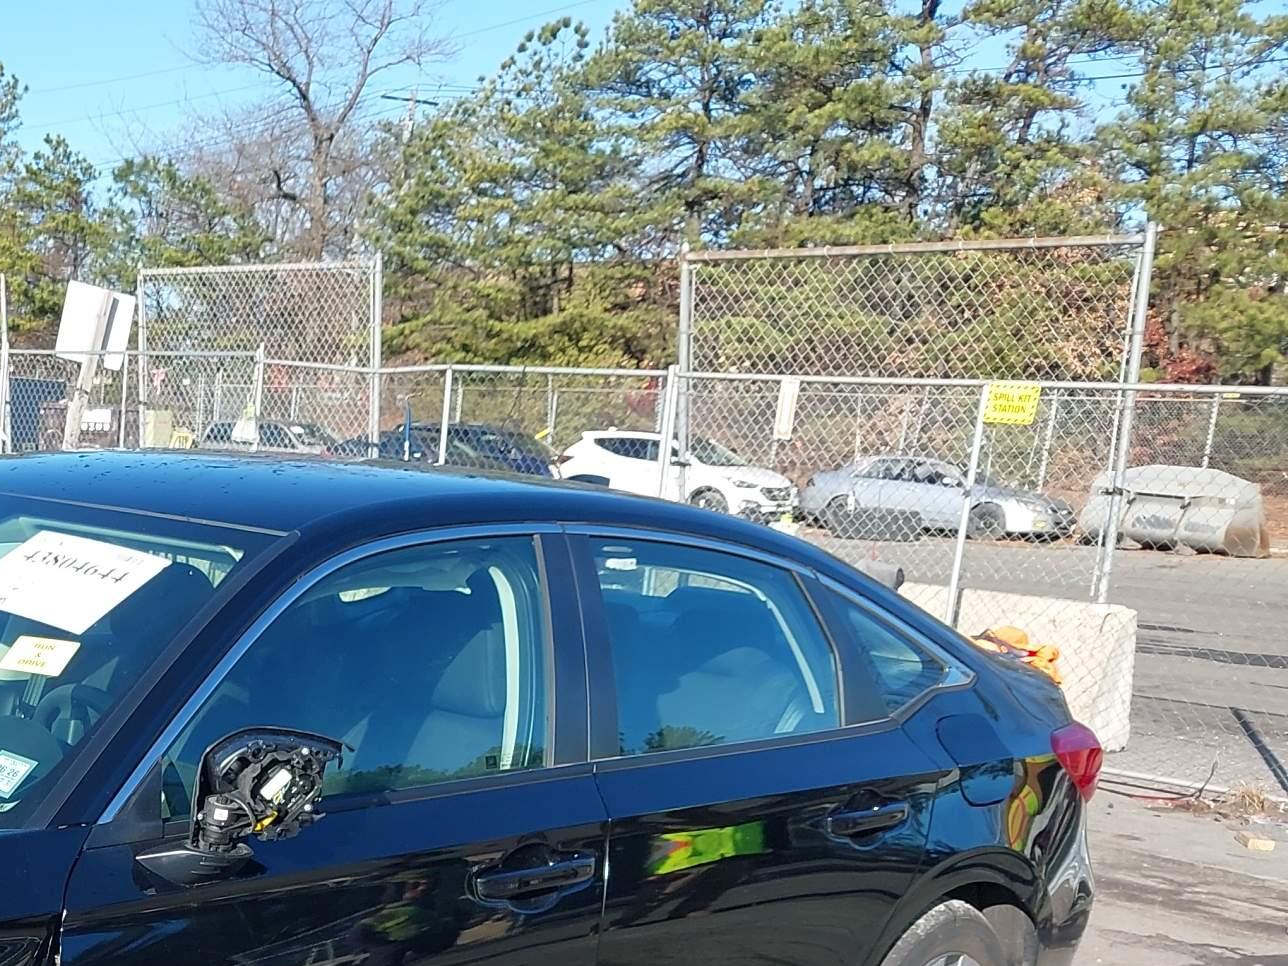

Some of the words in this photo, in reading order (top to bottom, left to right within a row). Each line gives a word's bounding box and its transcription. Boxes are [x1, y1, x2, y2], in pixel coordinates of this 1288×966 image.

[993, 392, 1015, 403] SPILL
[1018, 394, 1032, 403] KIT
[992, 403, 1026, 414] STATION
[23, 549, 131, 584] 43804644
